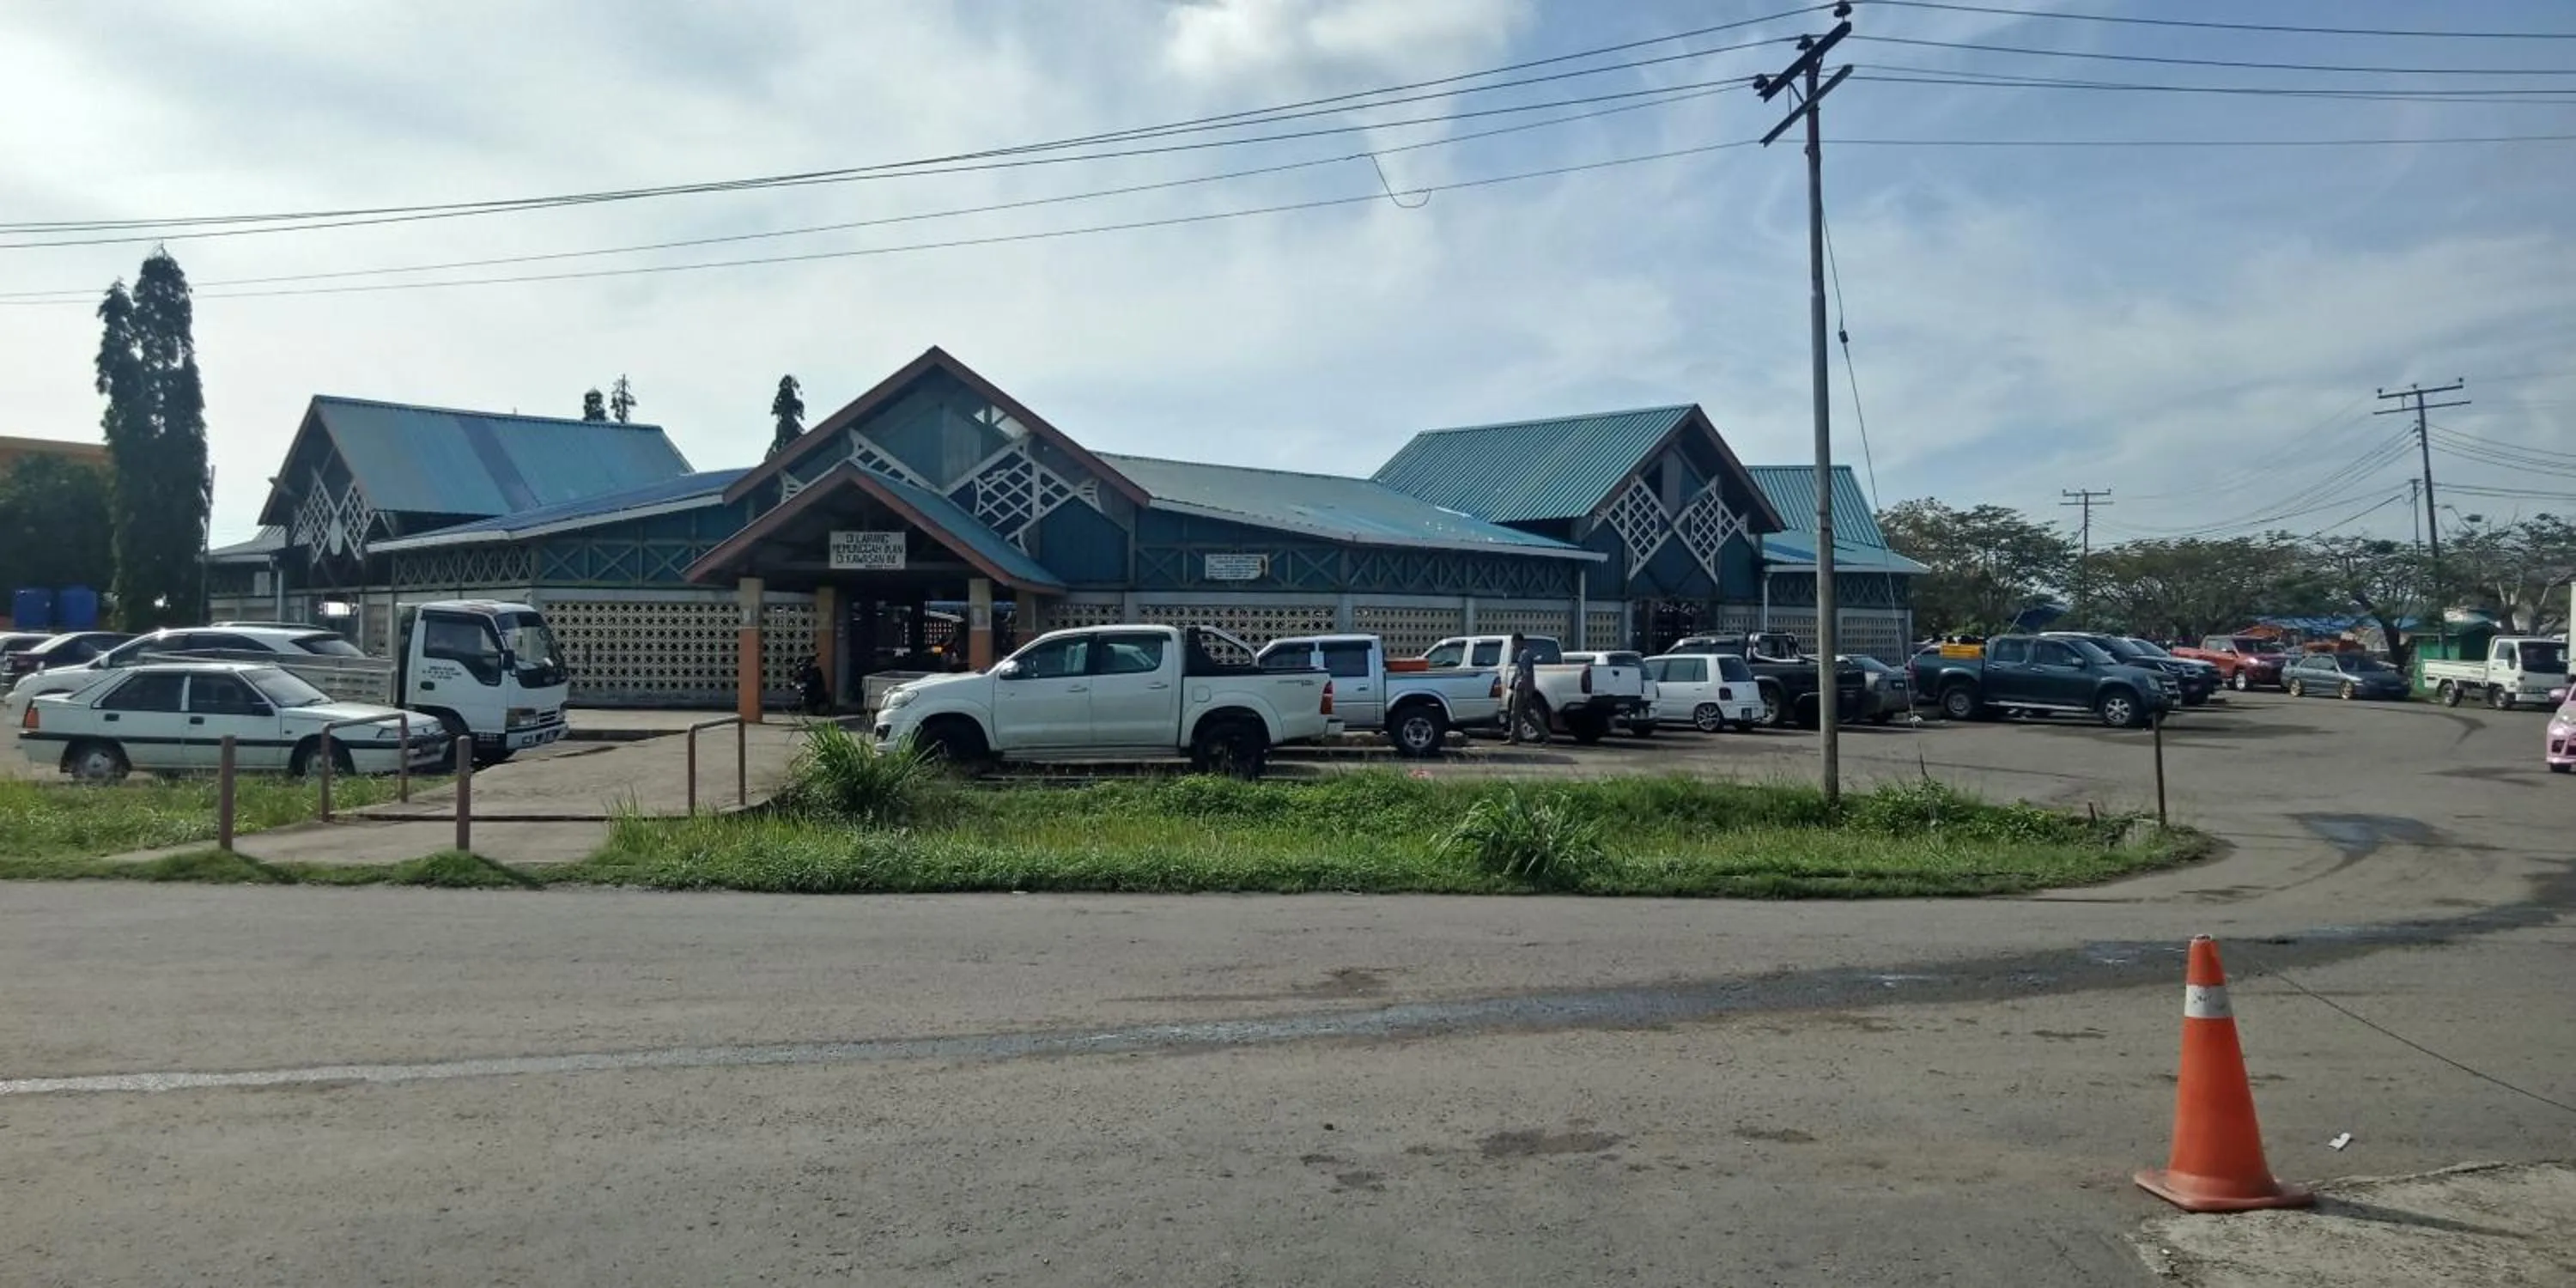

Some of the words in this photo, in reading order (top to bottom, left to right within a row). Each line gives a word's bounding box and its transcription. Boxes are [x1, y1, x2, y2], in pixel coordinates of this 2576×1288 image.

[846, 534, 854, 544] DI
[857, 534, 890, 544] LARANG
[884, 544, 904, 554] IKAN
[837, 555, 845, 564] DI
